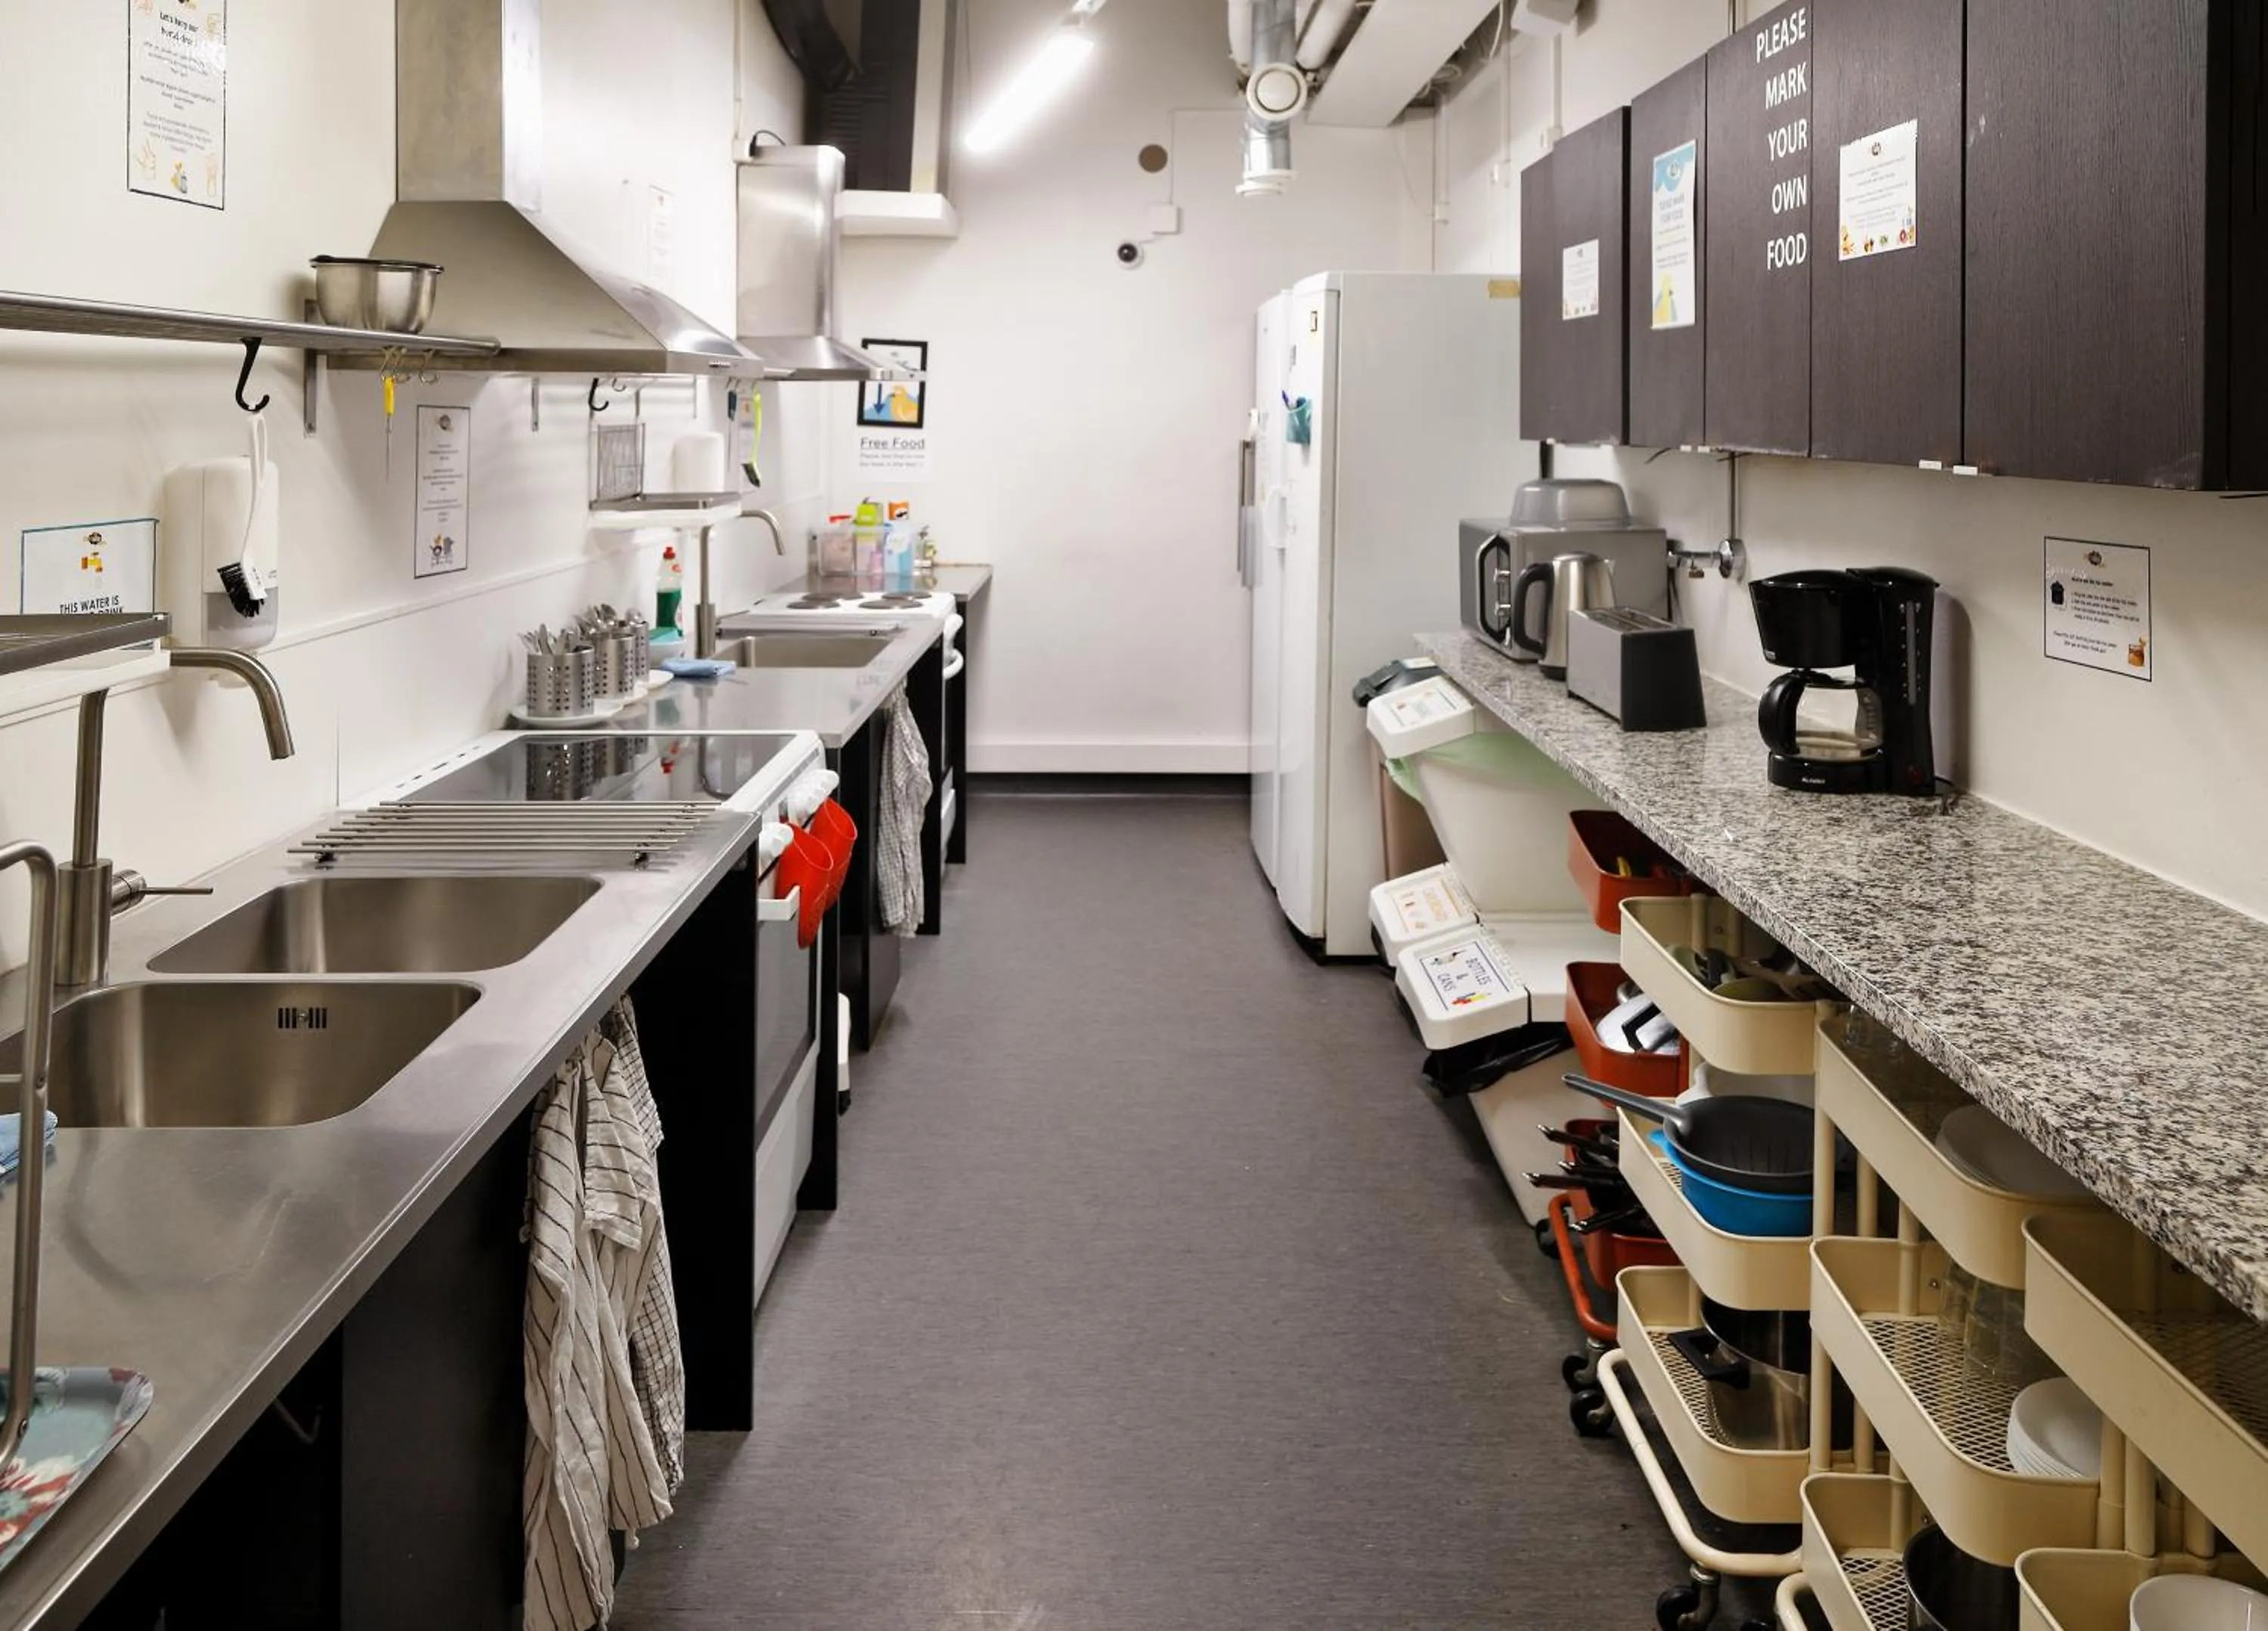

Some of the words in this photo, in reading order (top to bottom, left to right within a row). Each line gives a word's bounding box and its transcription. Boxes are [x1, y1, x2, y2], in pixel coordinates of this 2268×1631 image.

[1756, 8, 1806, 63] PLEASE
[1765, 62, 1808, 110] MARK
[1768, 118, 1808, 162] YOUR
[1771, 175, 1807, 215] OWN
[1766, 233, 1807, 271] FOOD
[860, 437, 888, 450] Free
[893, 437, 925, 450] Food
[60, 602, 78, 614] THIS
[80, 596, 110, 611] WATER
[111, 595, 119, 606] IS
[1437, 973, 1457, 992] CANS
[1465, 958, 1492, 986] BOTTLES
